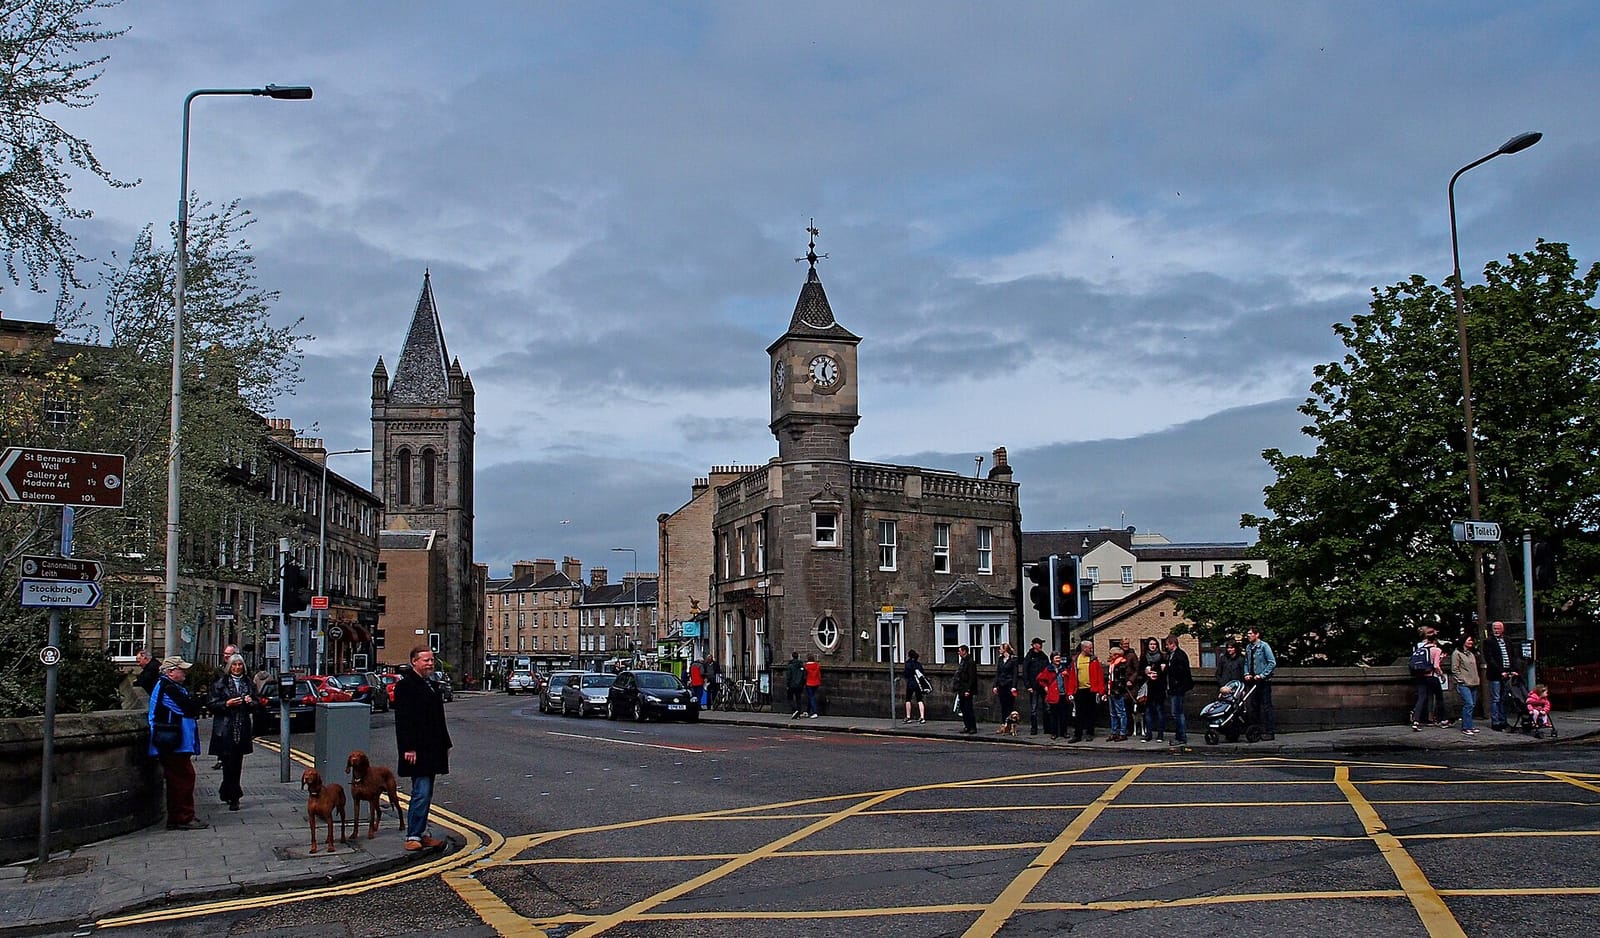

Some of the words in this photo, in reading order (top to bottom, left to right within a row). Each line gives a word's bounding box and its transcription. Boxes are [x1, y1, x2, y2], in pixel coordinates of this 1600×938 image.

[24, 453, 34, 461] St
[36, 454, 77, 464] Bernard's
[40, 462, 60, 470] Well
[26, 470, 57, 480] Gallery
[22, 479, 55, 488] Modern
[22, 491, 56, 500] Balerno
[1474, 526, 1496, 536] Toilets
[41, 560, 78, 570] Canonmills
[41, 569, 58, 577] Leith
[29, 584, 83, 594] Stockbridge
[40, 595, 72, 603] Church
